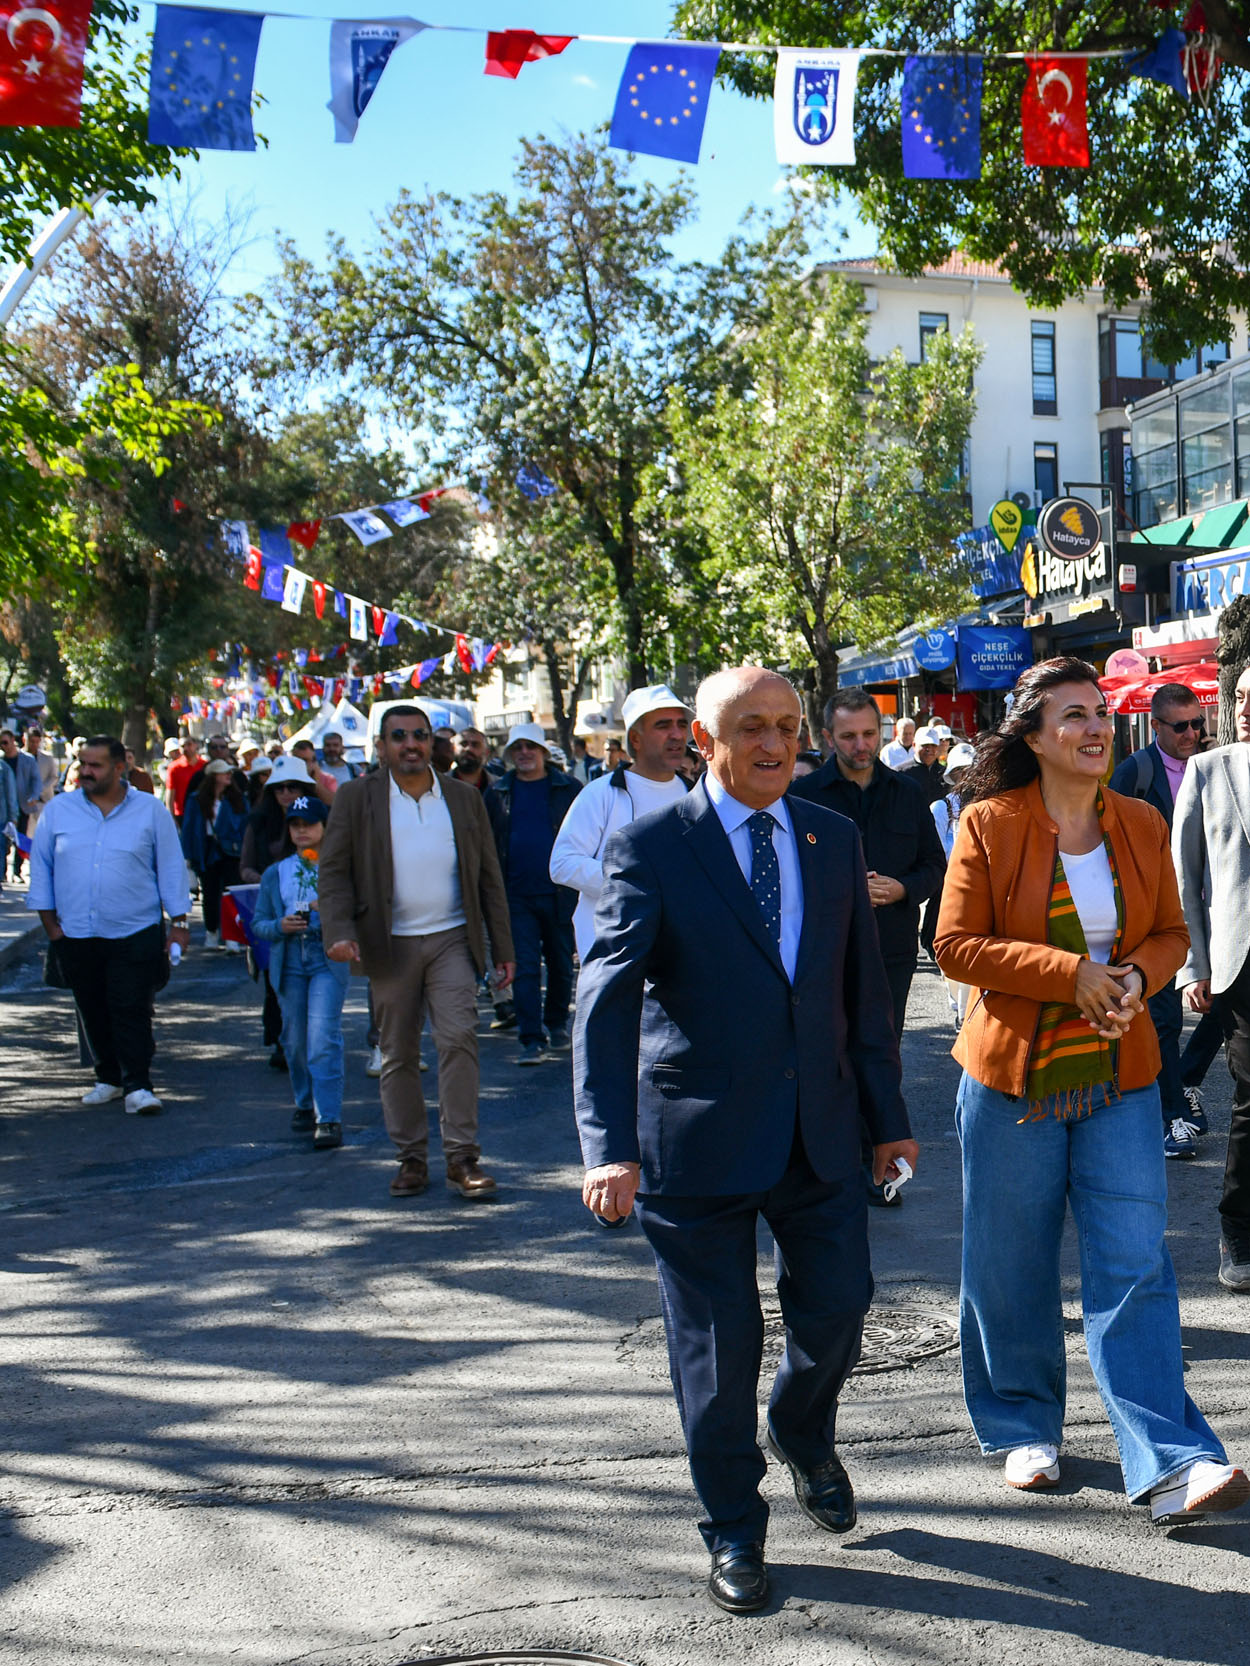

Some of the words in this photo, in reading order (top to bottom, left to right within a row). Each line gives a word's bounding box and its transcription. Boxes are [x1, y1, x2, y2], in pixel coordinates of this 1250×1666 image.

[1053, 530, 1091, 547] Hatayca
[1038, 541, 1106, 596] Hatayca
[984, 642, 1009, 652] NEŞE
[971, 651, 1024, 663] ÇİÇEKÇİLİK
